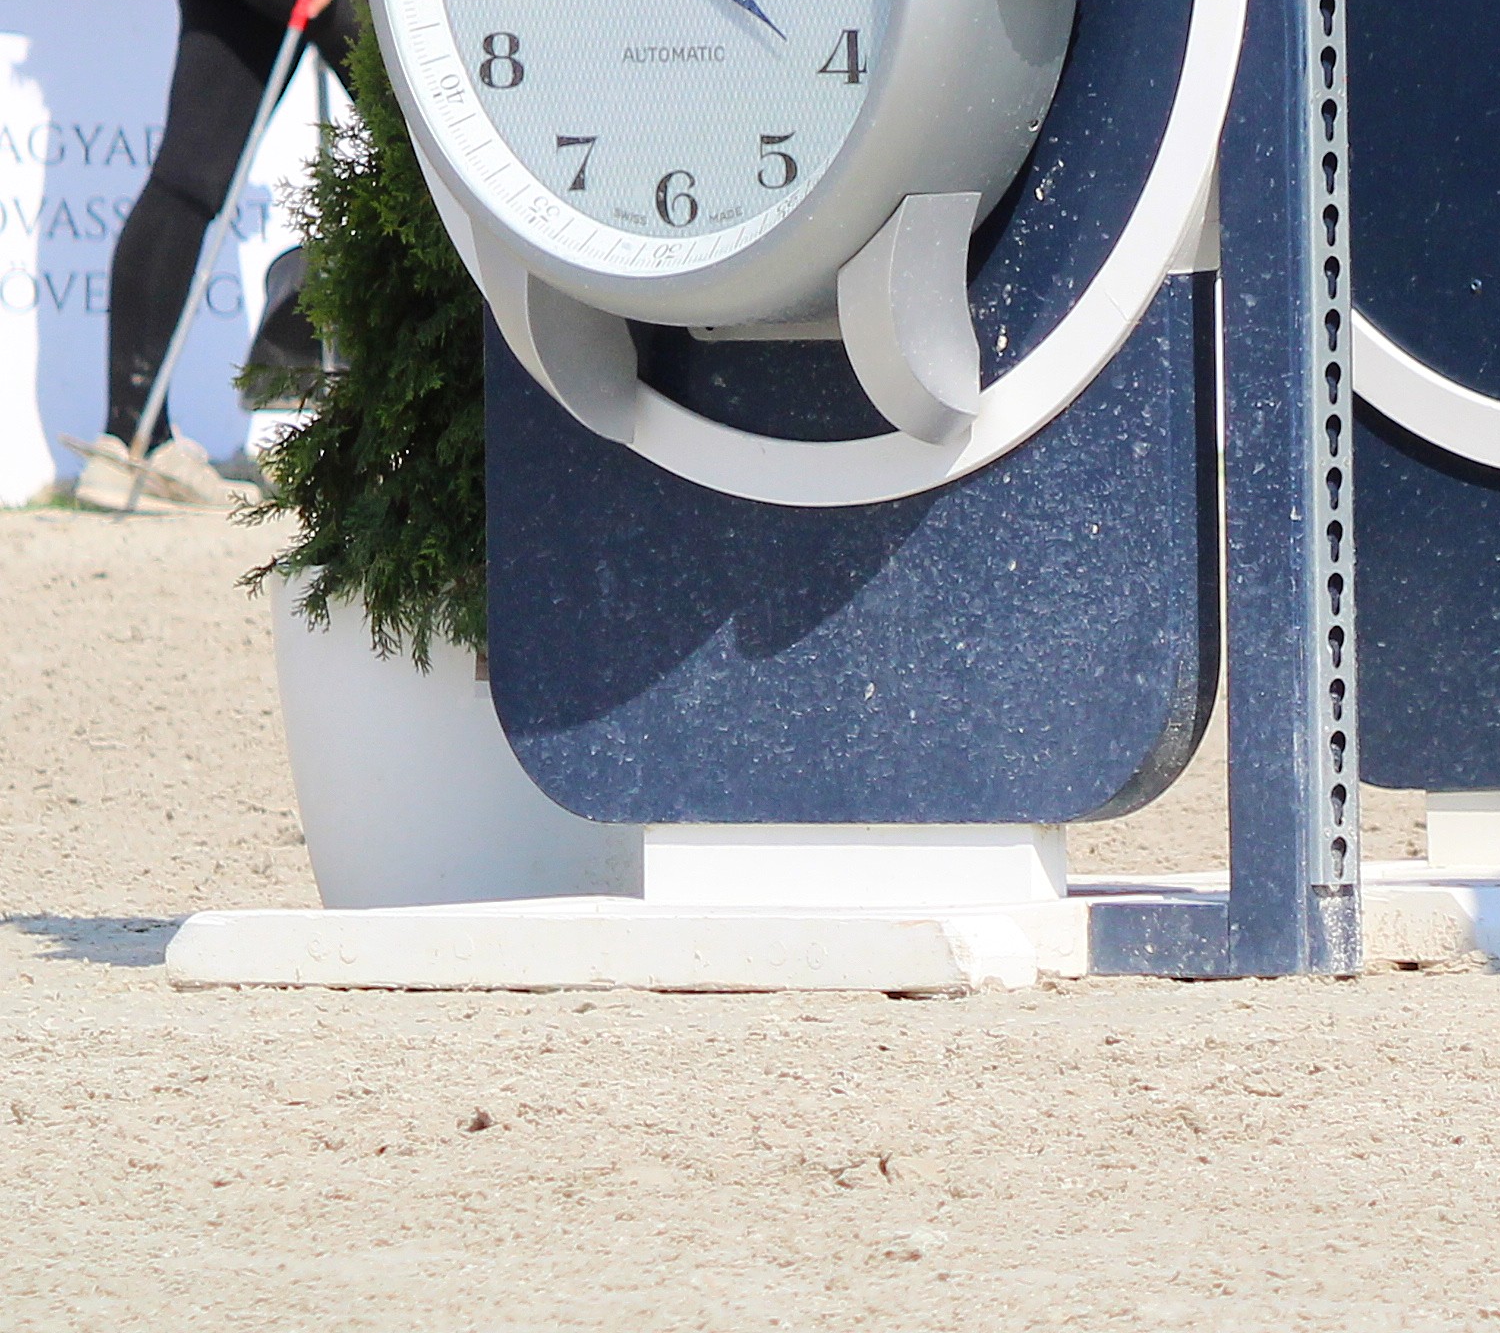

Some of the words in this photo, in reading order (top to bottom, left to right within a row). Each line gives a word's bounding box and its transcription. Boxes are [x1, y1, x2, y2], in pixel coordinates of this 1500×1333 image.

[479, 32, 525, 90] 8
[622, 45, 726, 64] AUTOMATIC
[817, 29, 868, 85] 4
[555, 134, 598, 192] 7
[757, 130, 798, 189] 5
[613, 208, 648, 226] SWISS
[709, 206, 743, 224] MADE
[655, 169, 699, 228] 6
